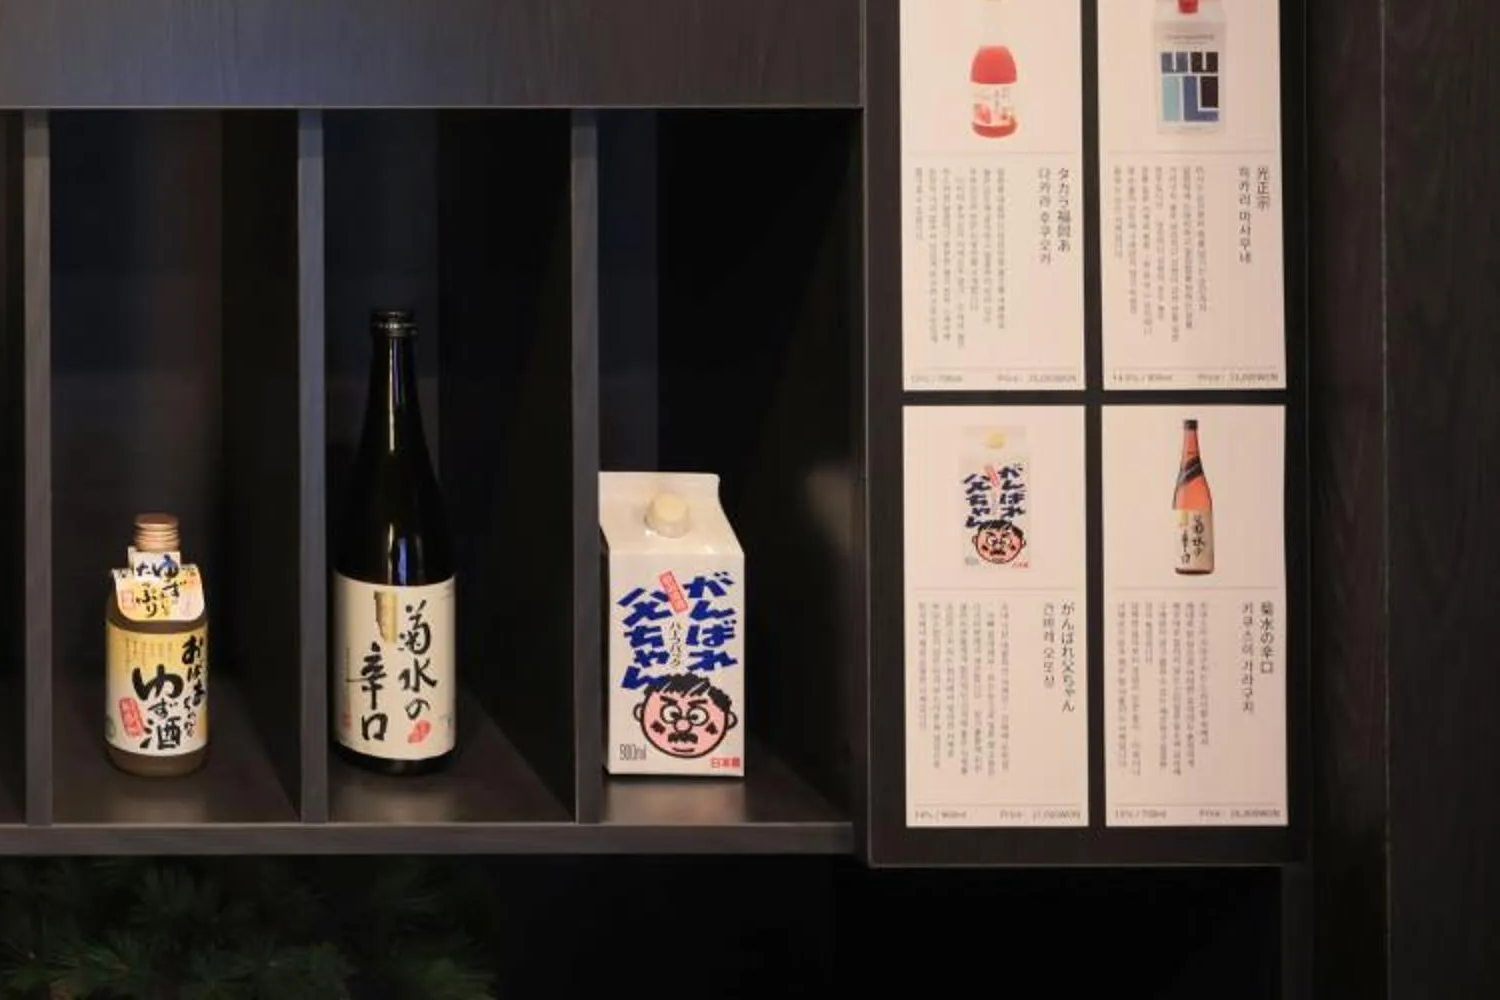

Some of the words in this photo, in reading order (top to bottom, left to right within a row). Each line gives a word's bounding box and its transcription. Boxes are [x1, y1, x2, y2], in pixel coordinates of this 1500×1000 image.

[397, 600, 438, 721] 菊水の
[616, 587, 673, 691] 父ちゃん
[682, 571, 739, 672] がんばれ
[131, 664, 185, 750] ゆず酒
[350, 641, 389, 742] 辛口
